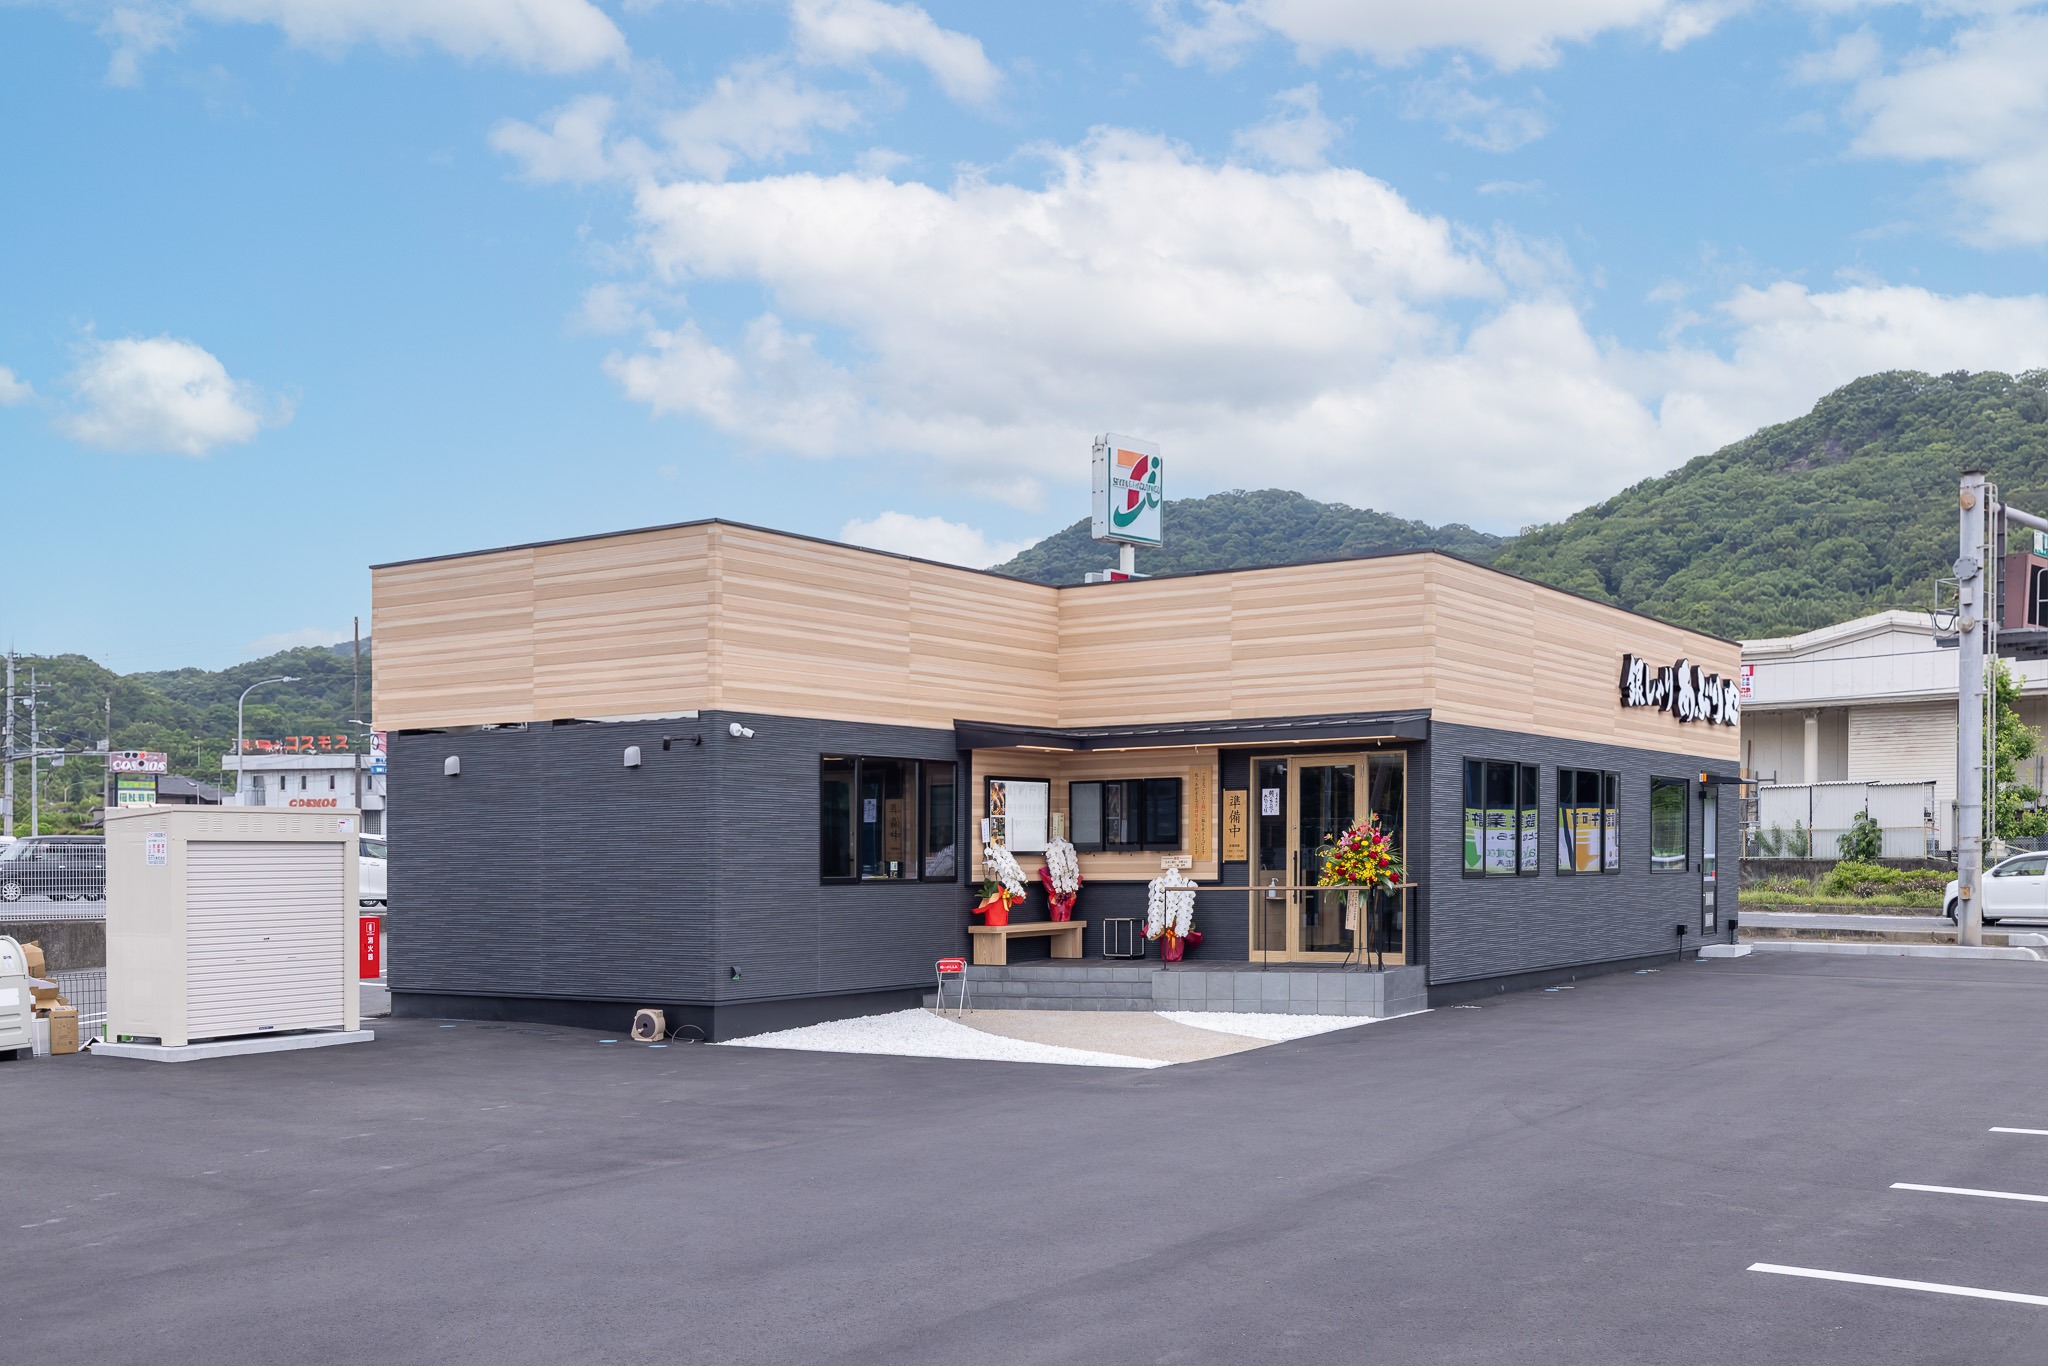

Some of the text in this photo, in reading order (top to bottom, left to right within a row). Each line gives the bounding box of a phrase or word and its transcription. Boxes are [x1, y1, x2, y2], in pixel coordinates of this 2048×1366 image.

[285, 734, 350, 753] コスモス
[1228, 795, 1241, 839] 準備中
